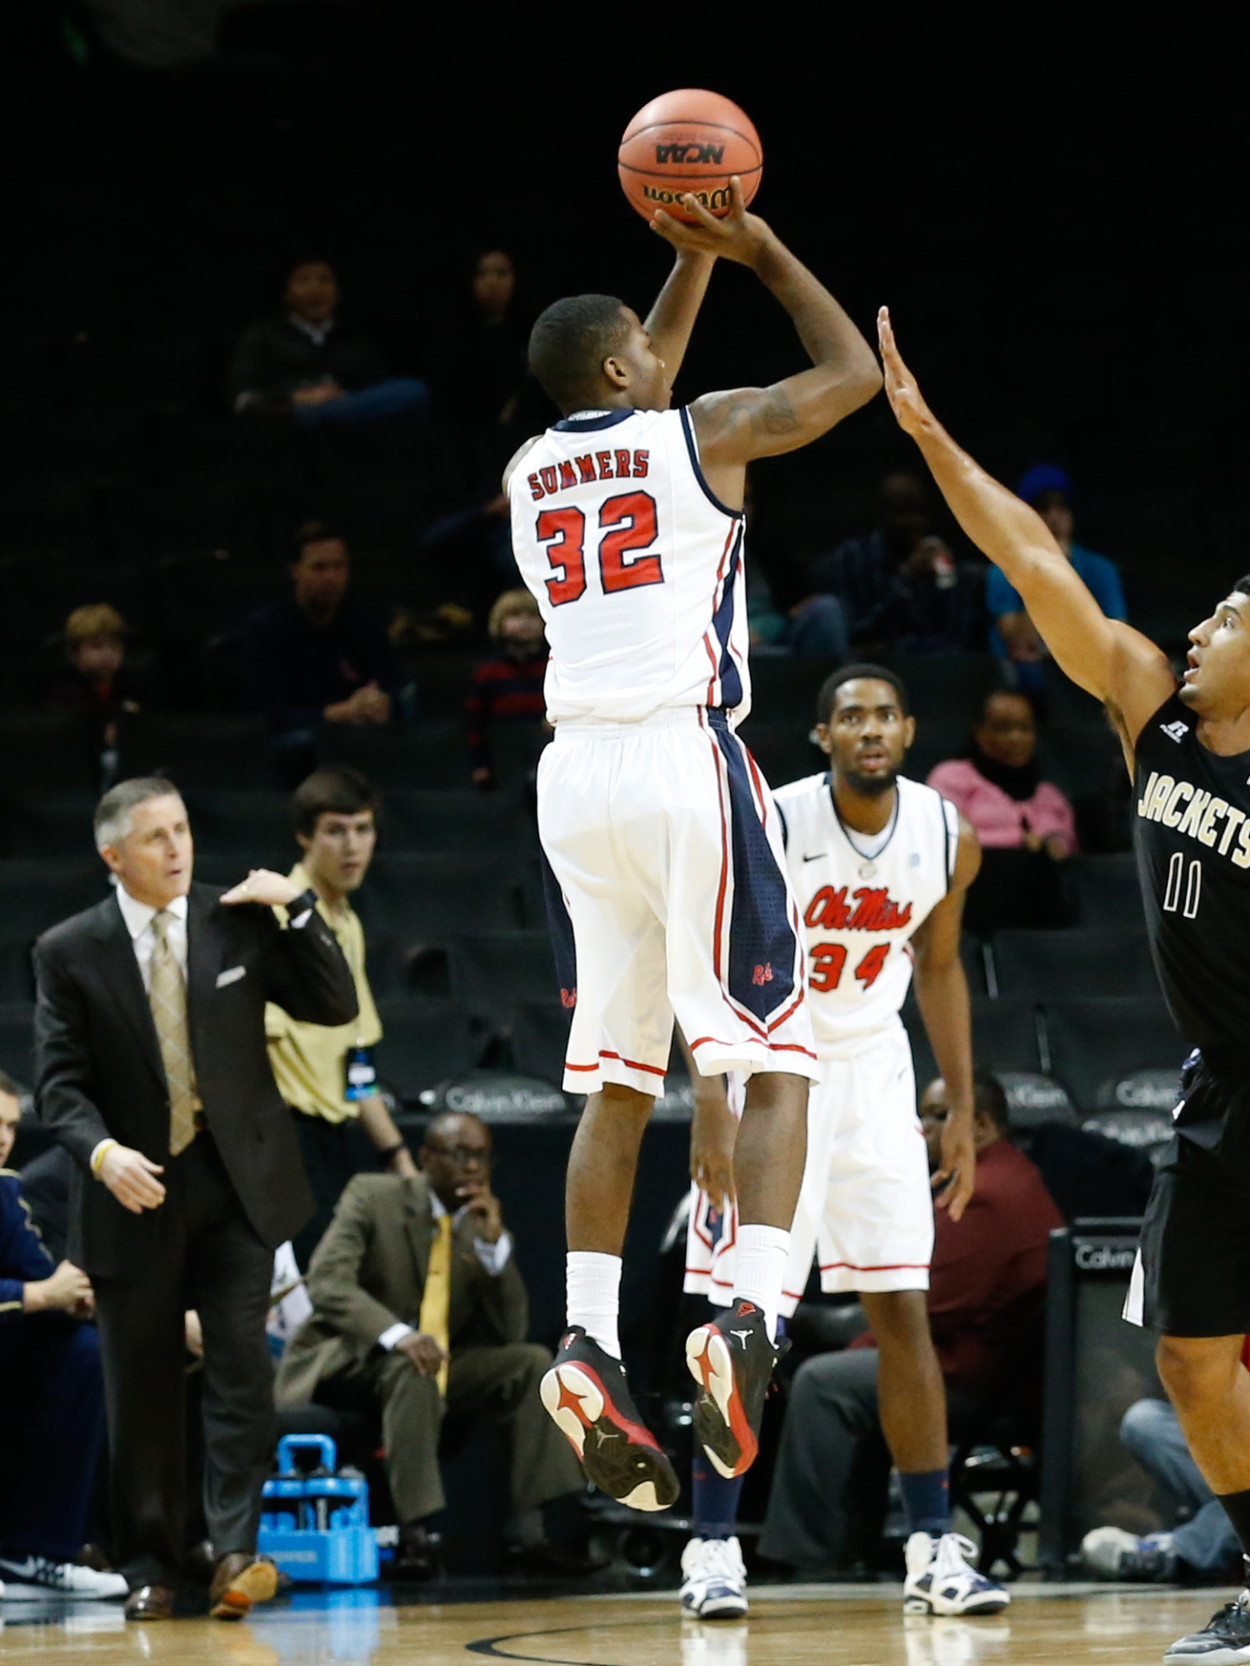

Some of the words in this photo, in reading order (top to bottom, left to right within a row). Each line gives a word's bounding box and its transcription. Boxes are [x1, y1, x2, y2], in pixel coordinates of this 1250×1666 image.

[656, 144, 724, 165] NCAA
[643, 185, 731, 210] Wison
[527, 449, 650, 501] SUMMERS
[536, 490, 665, 607] 32
[852, 887, 913, 931] Miss
[1163, 852, 1202, 919] 11
[808, 941, 892, 993] 34
